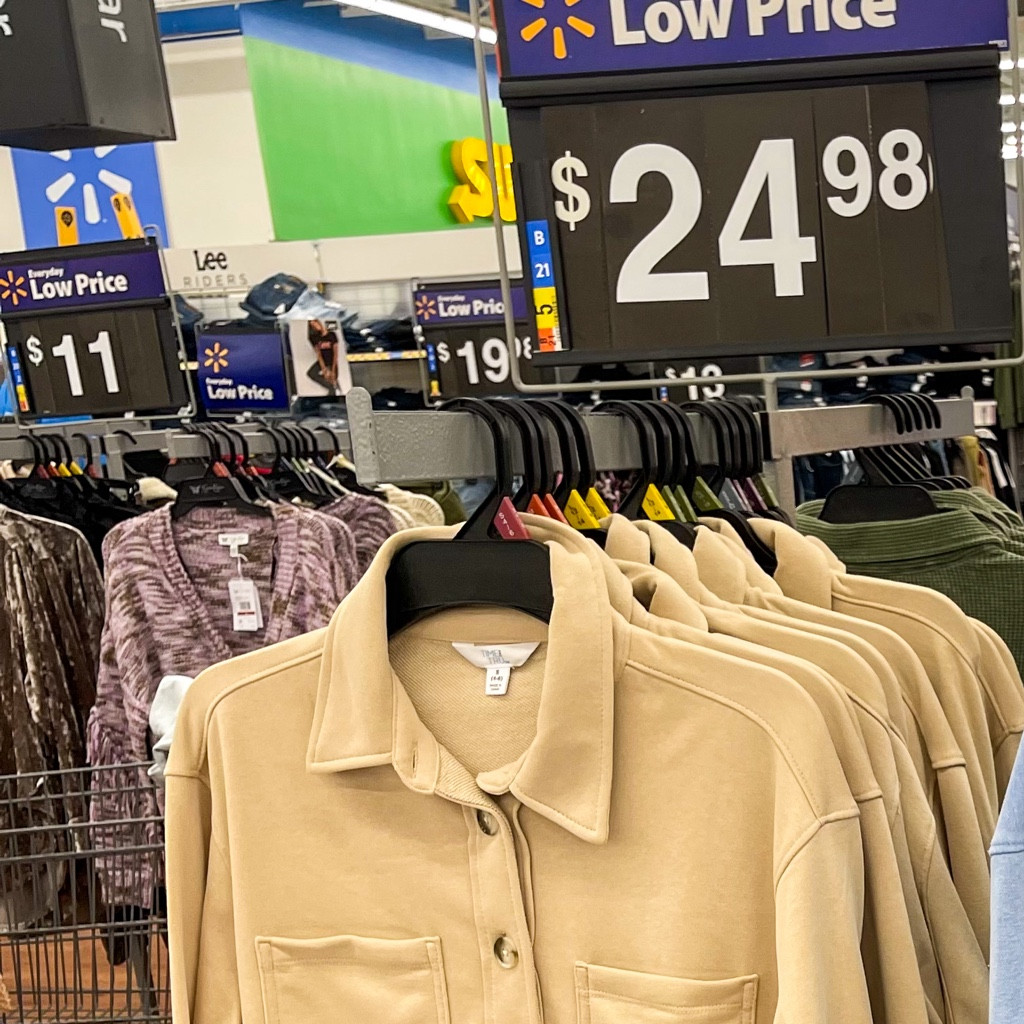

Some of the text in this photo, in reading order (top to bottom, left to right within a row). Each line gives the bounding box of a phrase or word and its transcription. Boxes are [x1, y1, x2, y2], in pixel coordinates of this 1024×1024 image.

[609, 0, 898, 46] Low Price
[193, 249, 228, 271] Lee
[535, 262, 551, 279] 21
[29, 271, 129, 300] Low Price
[183, 273, 248, 288] RIDERS
[438, 302, 471, 317] Low
[207, 384, 274, 400] Low Price
